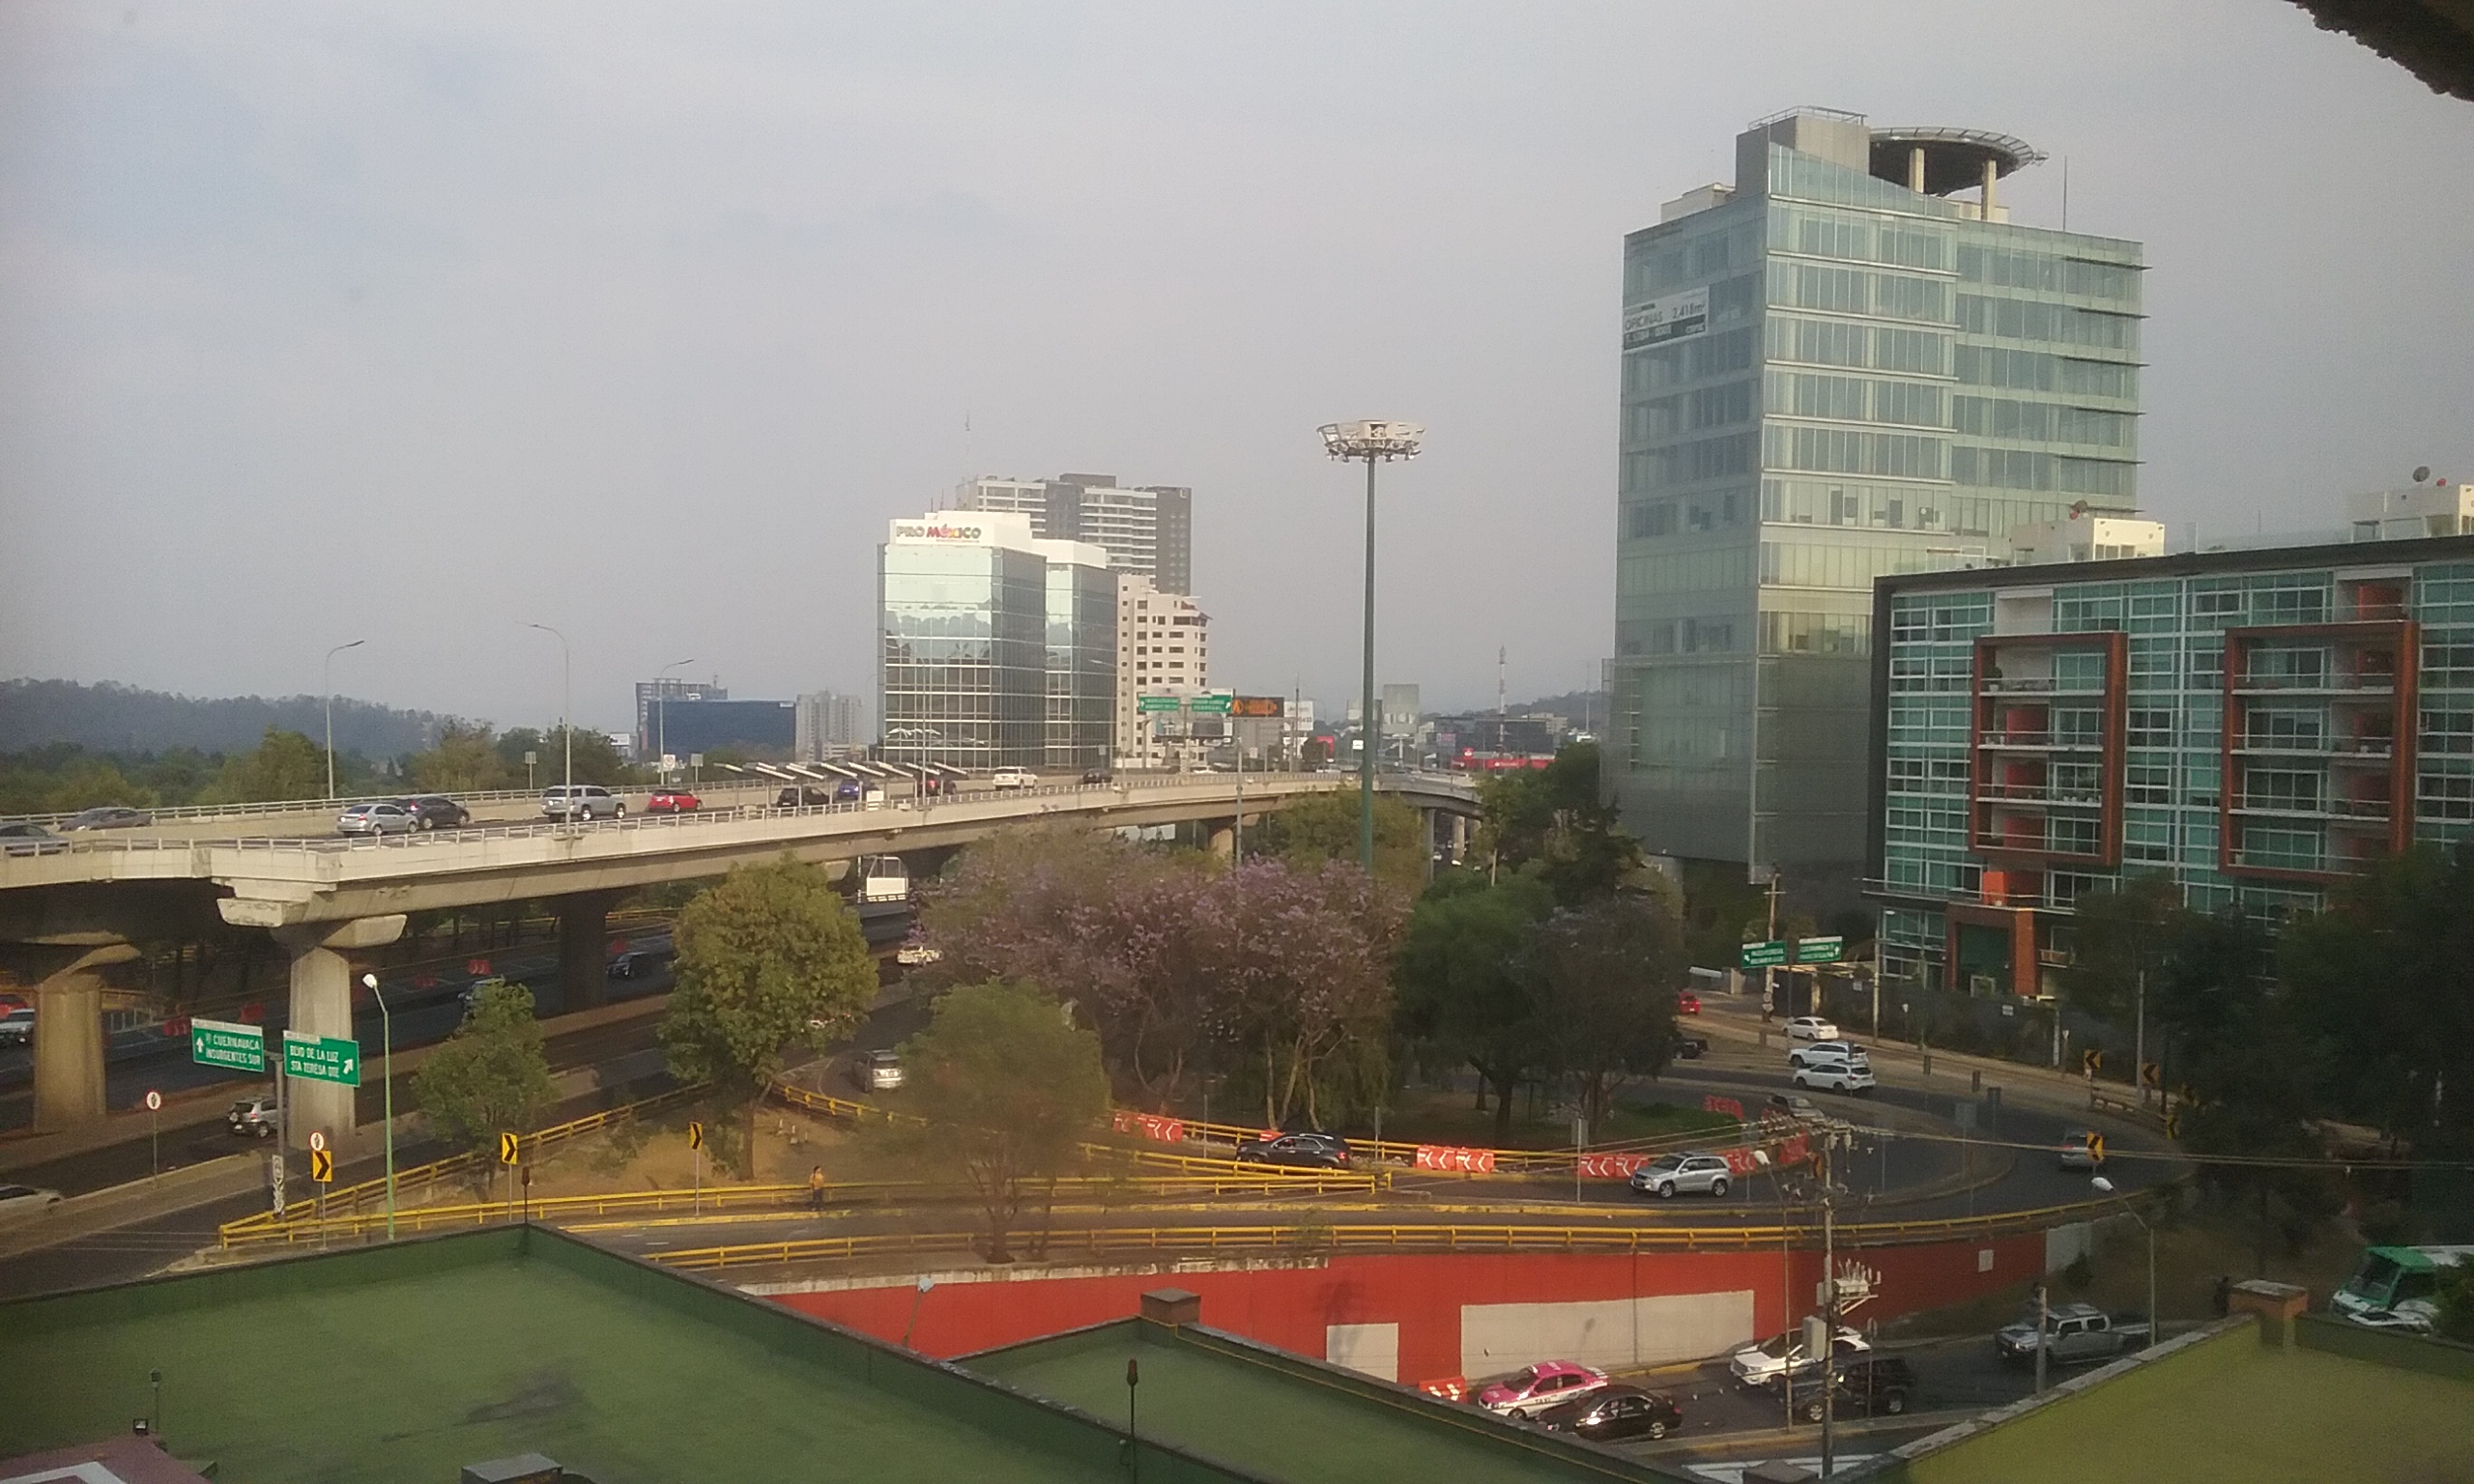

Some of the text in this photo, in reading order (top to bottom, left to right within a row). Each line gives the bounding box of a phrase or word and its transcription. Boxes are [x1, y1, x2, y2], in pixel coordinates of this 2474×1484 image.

[896, 526, 925, 537] PRO
[213, 1034, 260, 1051] CUERNAVACA
[248, 1053, 261, 1065] SUR
[306, 1047, 315, 1060] DE
[316, 1049, 326, 1061] LA
[326, 1051, 339, 1063] LUZ
[290, 1060, 302, 1071] STA
